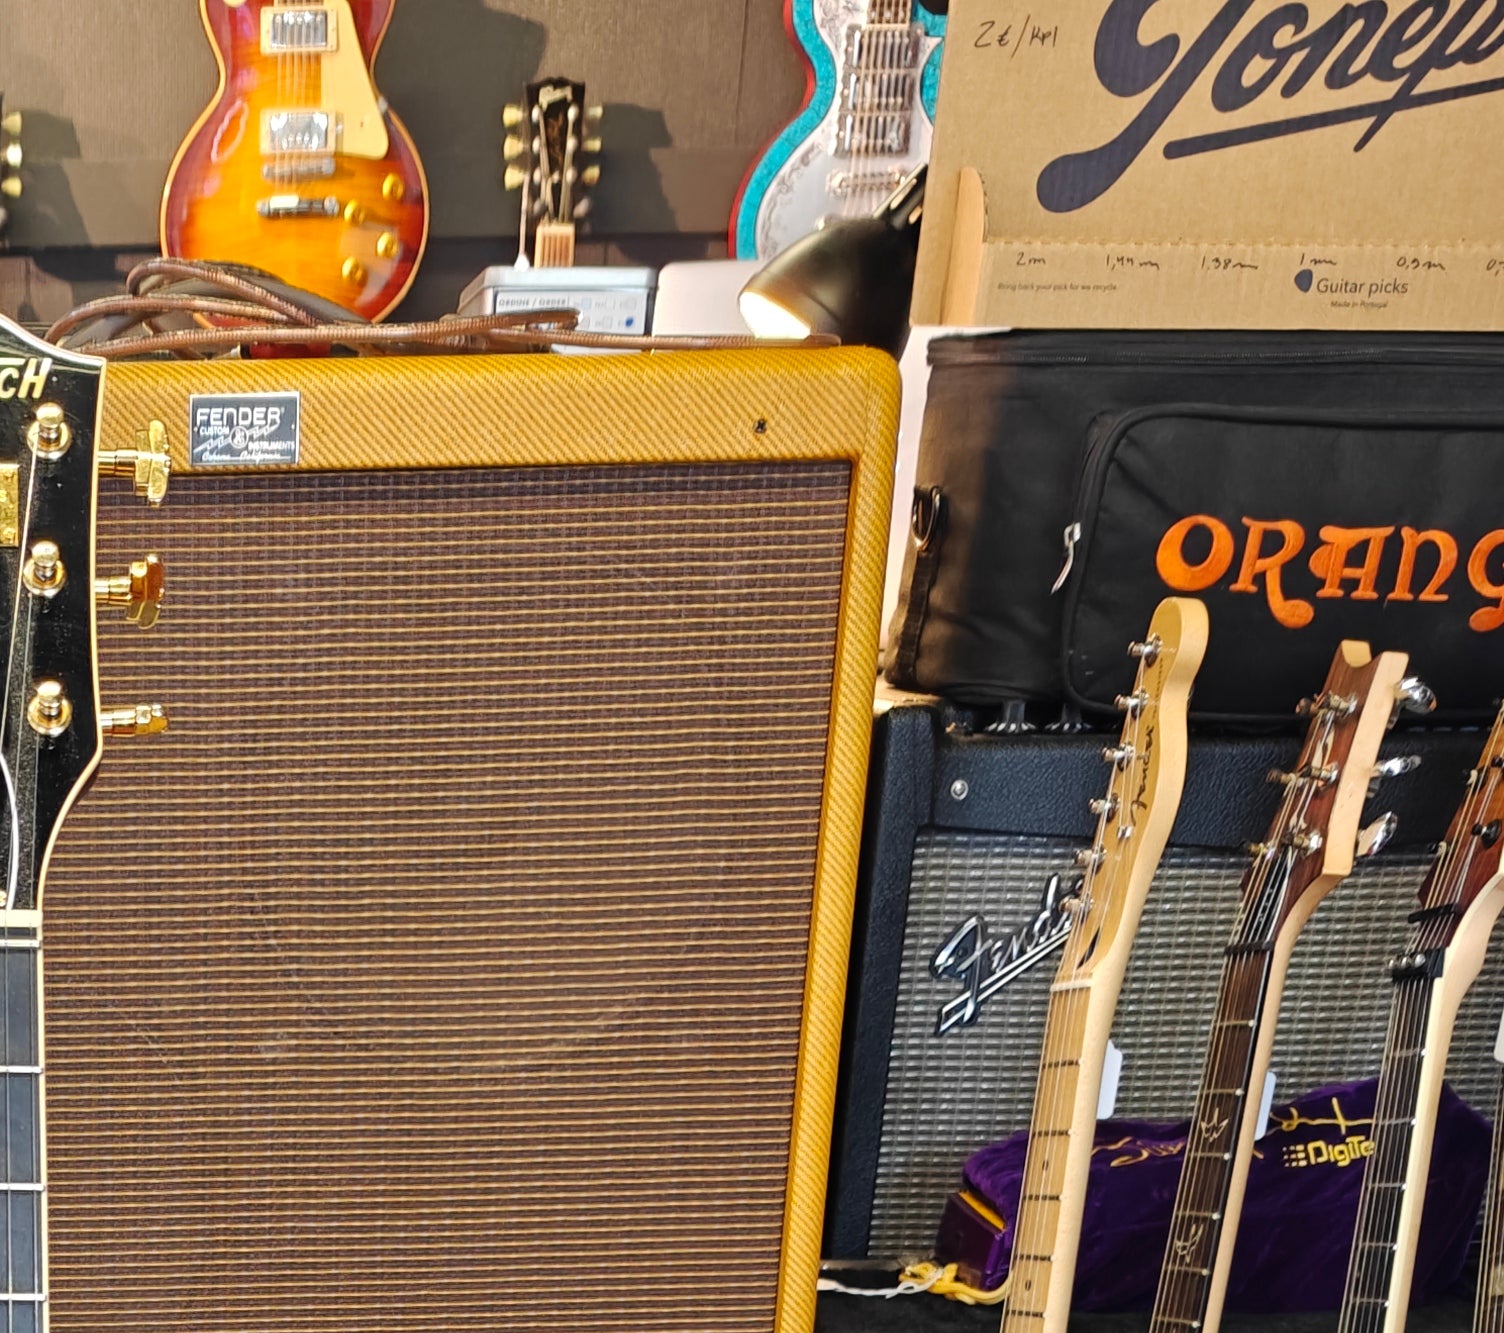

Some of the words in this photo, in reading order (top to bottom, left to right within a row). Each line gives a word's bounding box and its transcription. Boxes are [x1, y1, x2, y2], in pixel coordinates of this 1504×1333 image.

[1316, 277, 1364, 294] Guitar
[1368, 278, 1408, 298] picks
[197, 406, 281, 427] FENDER
[199, 426, 230, 436] CUSTOM
[248, 441, 295, 451] INSTRUMENTS
[1308, 1135, 1374, 1169] DigiTe
